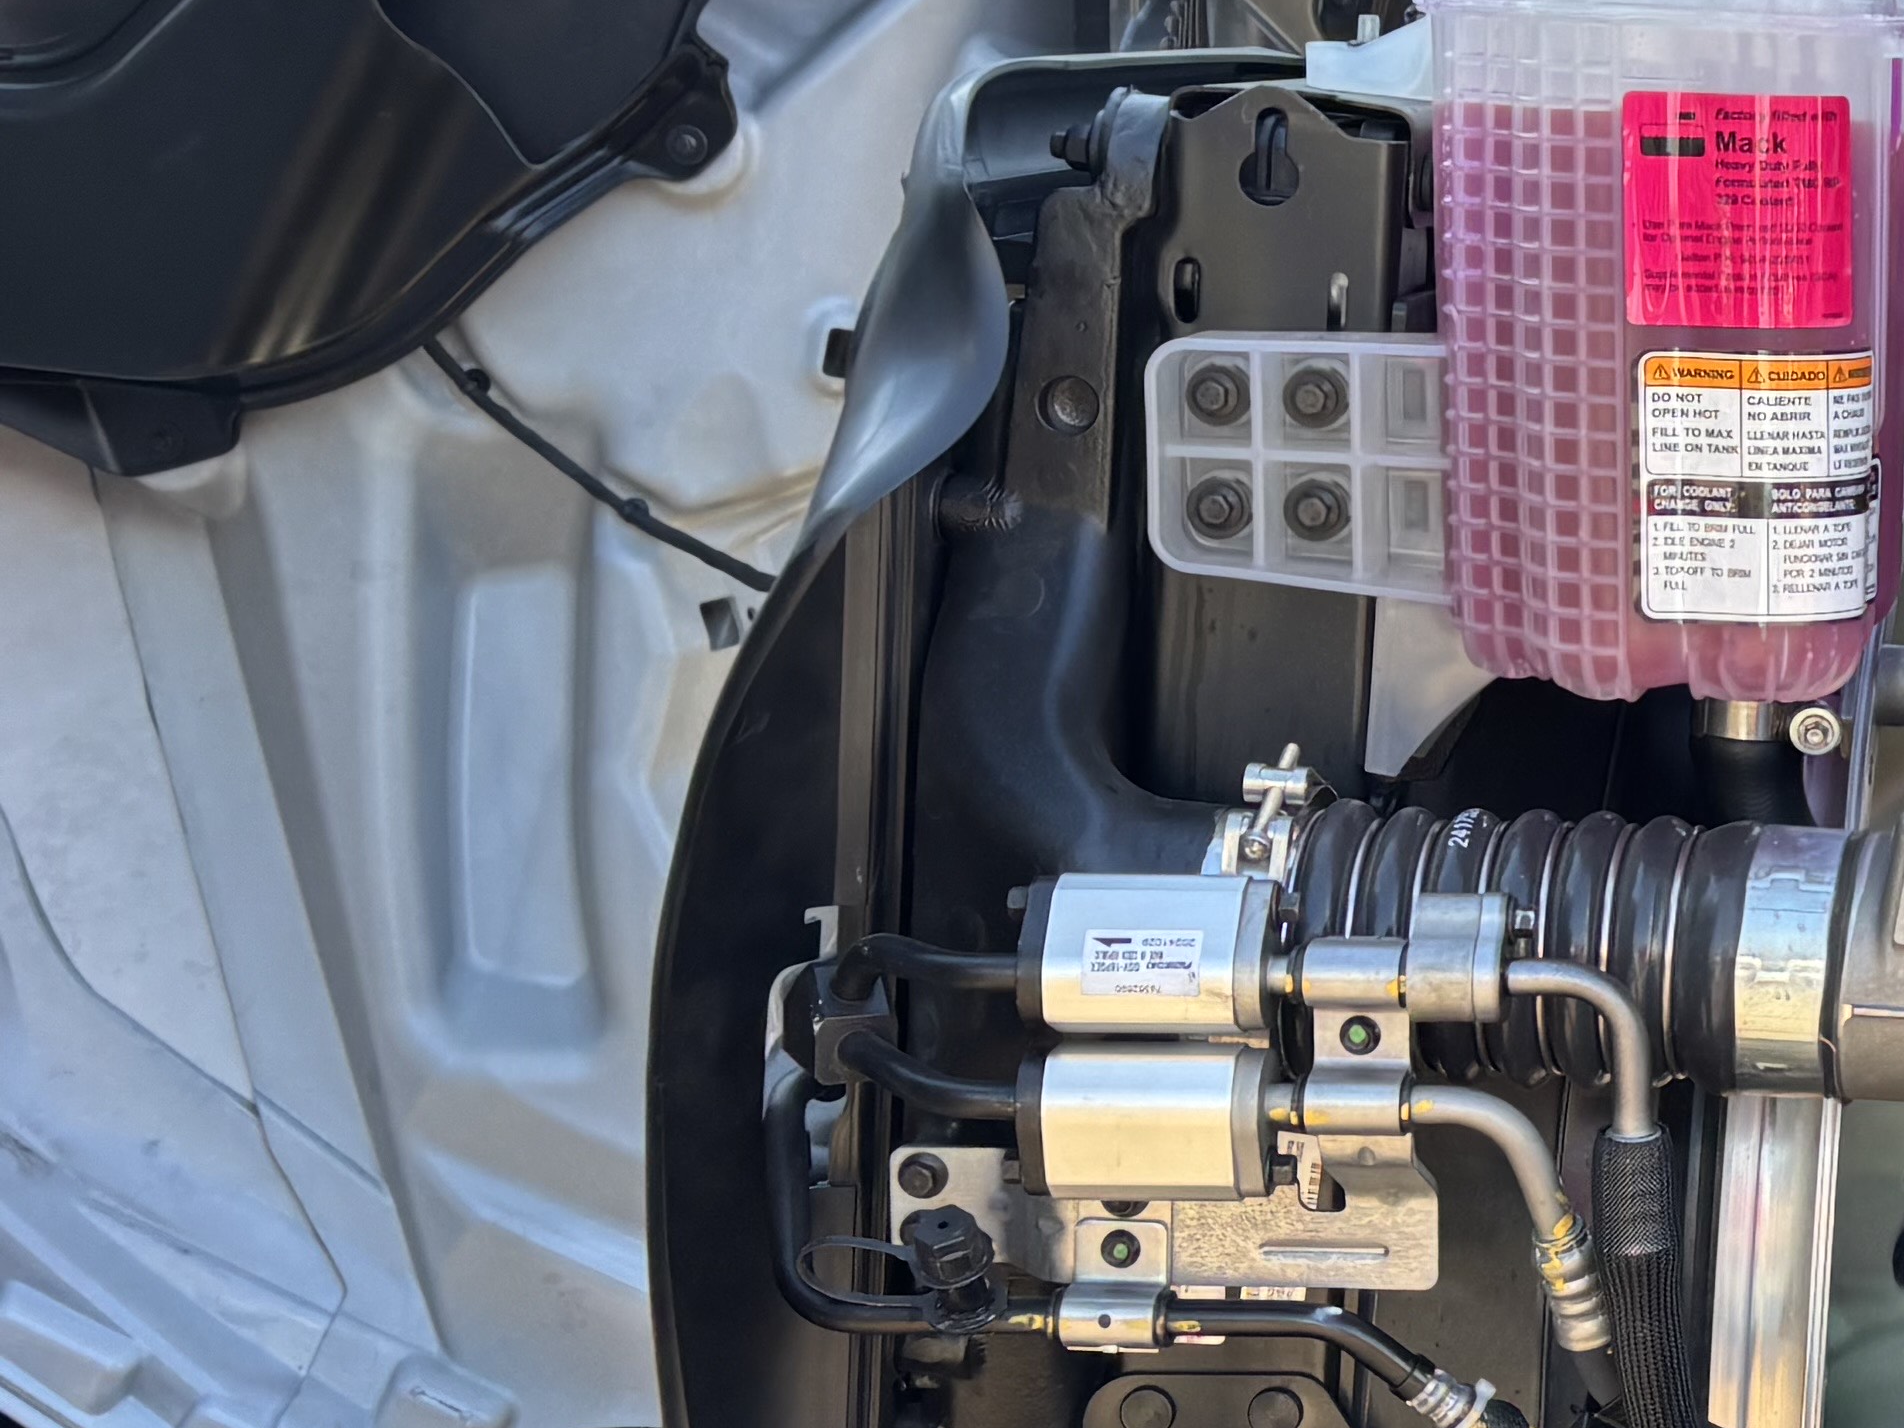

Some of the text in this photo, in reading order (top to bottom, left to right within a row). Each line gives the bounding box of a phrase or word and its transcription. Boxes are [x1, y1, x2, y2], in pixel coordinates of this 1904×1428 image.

[1716, 132, 1787, 154] Mack
[1672, 368, 1734, 380] WARNING
[1768, 371, 1826, 381] CUIDADO
[1652, 393, 1702, 403] DO NOT
[1748, 396, 1812, 406] CALIENTE
[1652, 409, 1720, 420] OPEN HOT
[1748, 412, 1812, 422] NO ABRIR
[1652, 428, 1732, 439] FILL TO MAX
[1747, 431, 1789, 440] LLENAR
[1792, 430, 1826, 440] HASTA
[1652, 443, 1739, 454] LINE ON TANK
[1748, 462, 1809, 471] EN TANQUE
[1654, 485, 1732, 497] FOR COOLANT
[1772, 488, 1801, 499] SOLO
[1806, 487, 1831, 498] PARA
[1654, 500, 1699, 511] CHANGE
[1663, 523, 1682, 531] FILL
[1688, 523, 1700, 532] TO
[1704, 524, 1728, 533] BRIM
[1732, 524, 1756, 534] FULL
[1690, 538, 1725, 548] ENGINE
[1729, 540, 1735, 548] 2
[1784, 568, 1805, 578] POR
[1809, 568, 1815, 577] 2
[1664, 581, 1687, 591] FULL
[1835, 582, 1840, 590] A
